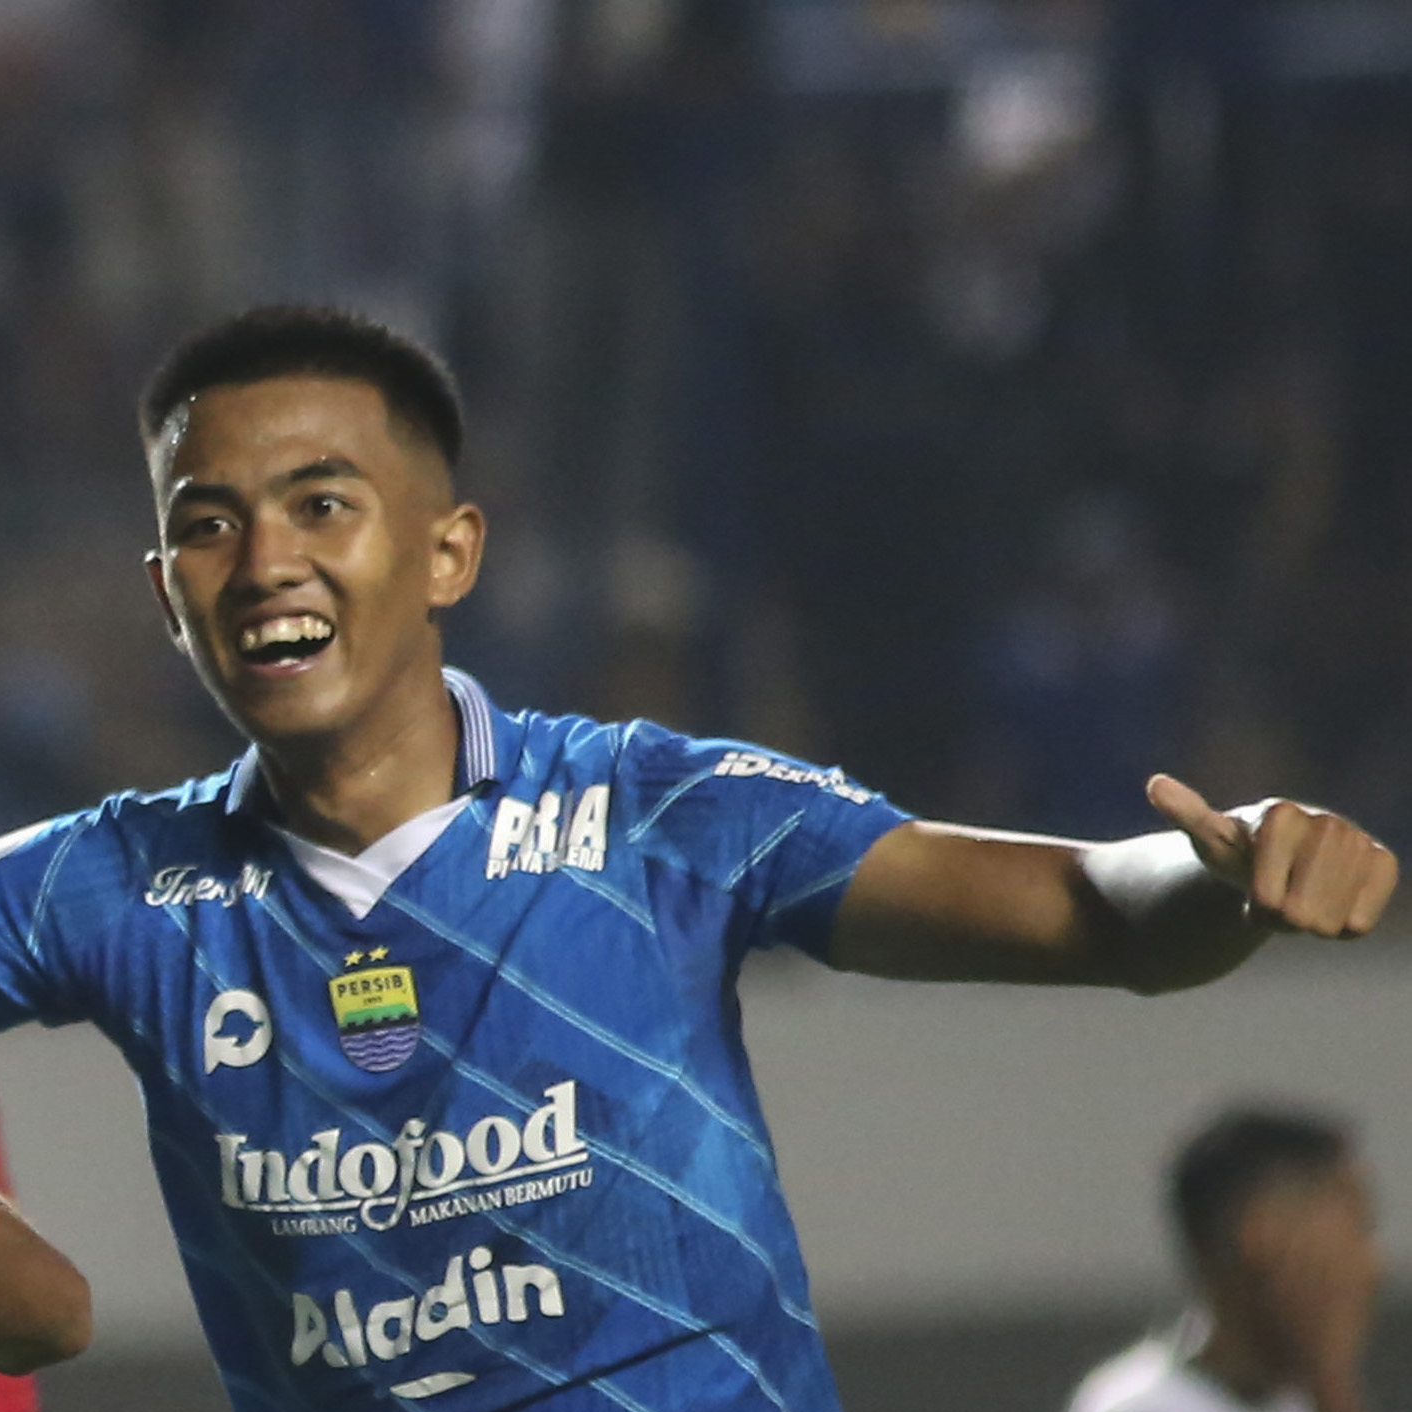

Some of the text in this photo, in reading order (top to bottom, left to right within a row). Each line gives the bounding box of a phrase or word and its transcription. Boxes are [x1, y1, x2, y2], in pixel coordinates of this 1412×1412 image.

[338, 975, 402, 998] PERSIB
[214, 1080, 588, 1232] Indofood
[271, 1167, 595, 1237] LAMBANG MAKANAN BERMUTU
[291, 1246, 565, 1368] Aladin
